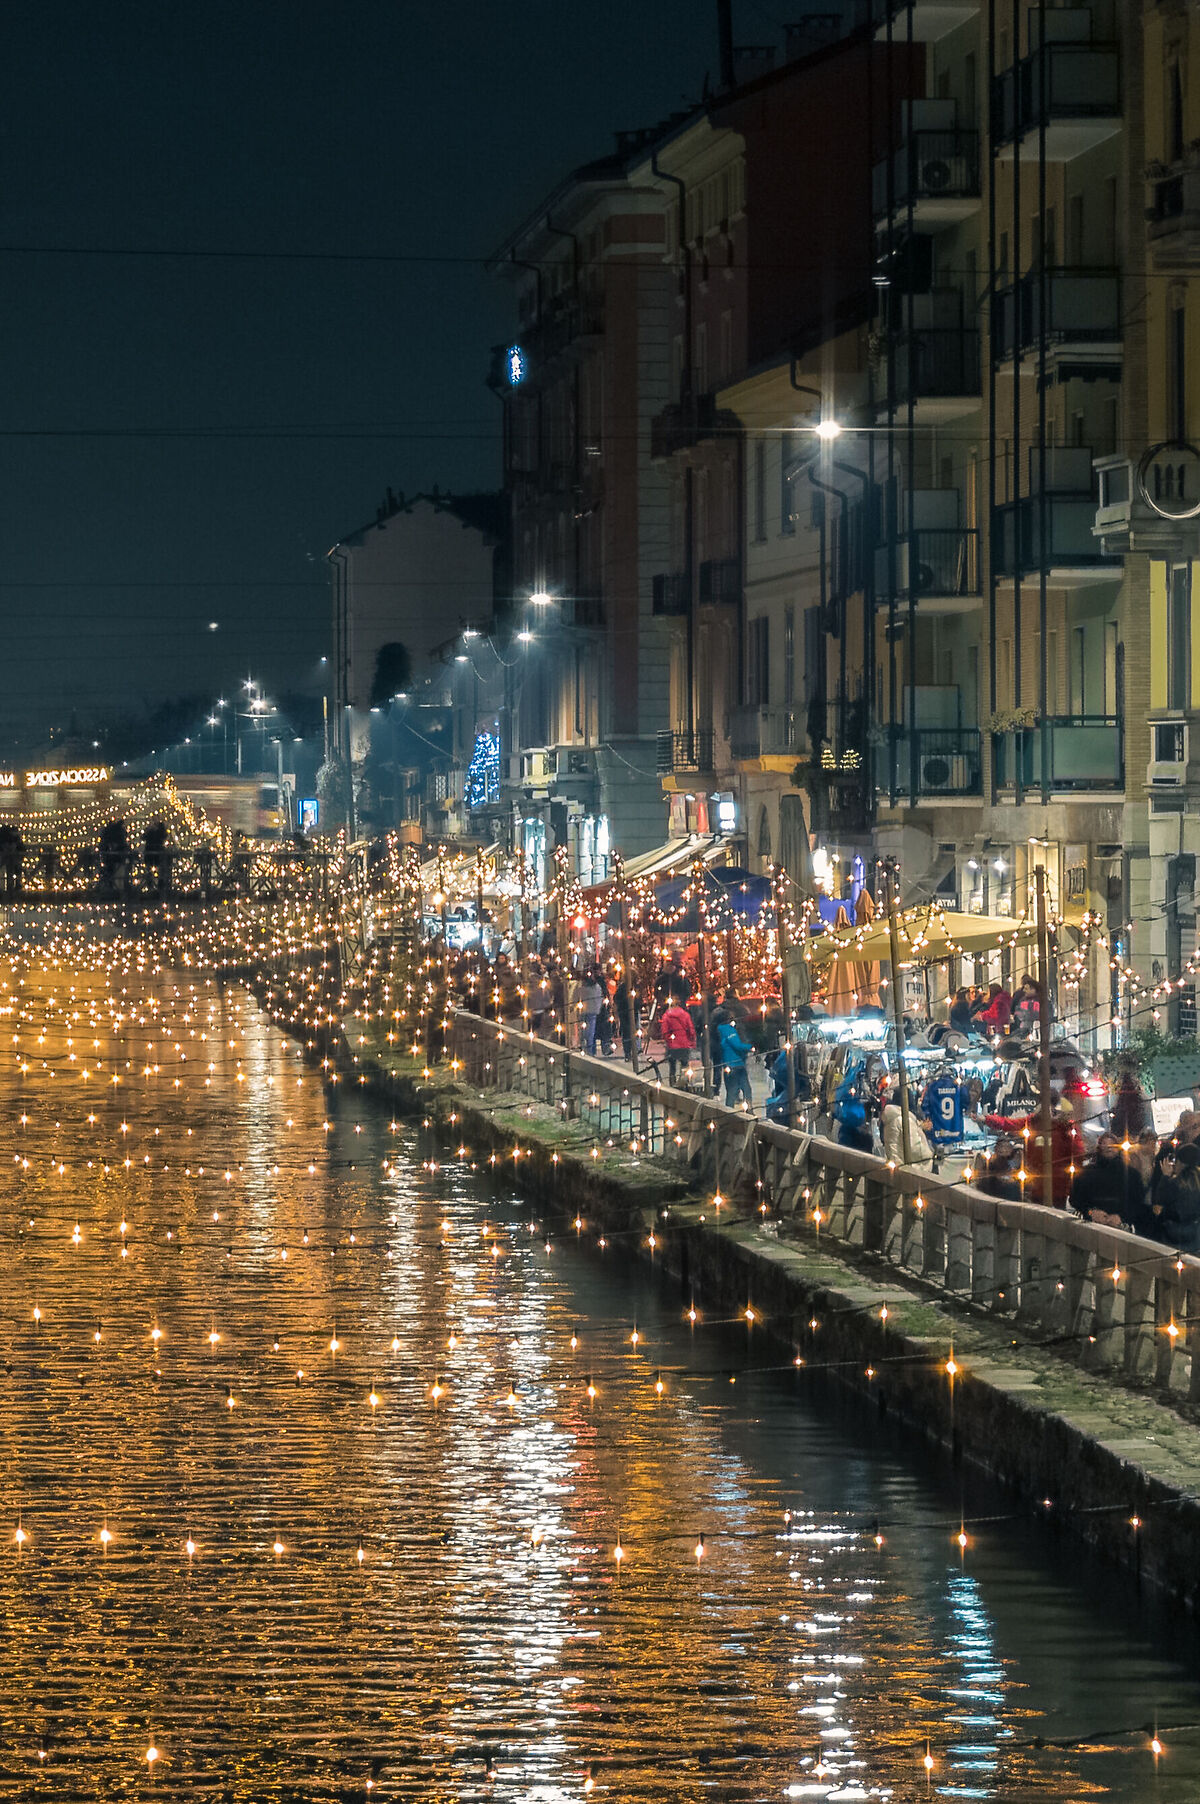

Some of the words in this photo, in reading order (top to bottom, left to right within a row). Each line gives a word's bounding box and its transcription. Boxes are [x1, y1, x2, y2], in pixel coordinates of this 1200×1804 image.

[936, 899, 956, 907] ATM
[1006, 1099, 1037, 1107] MILANO
[941, 1096, 955, 1120] 9
